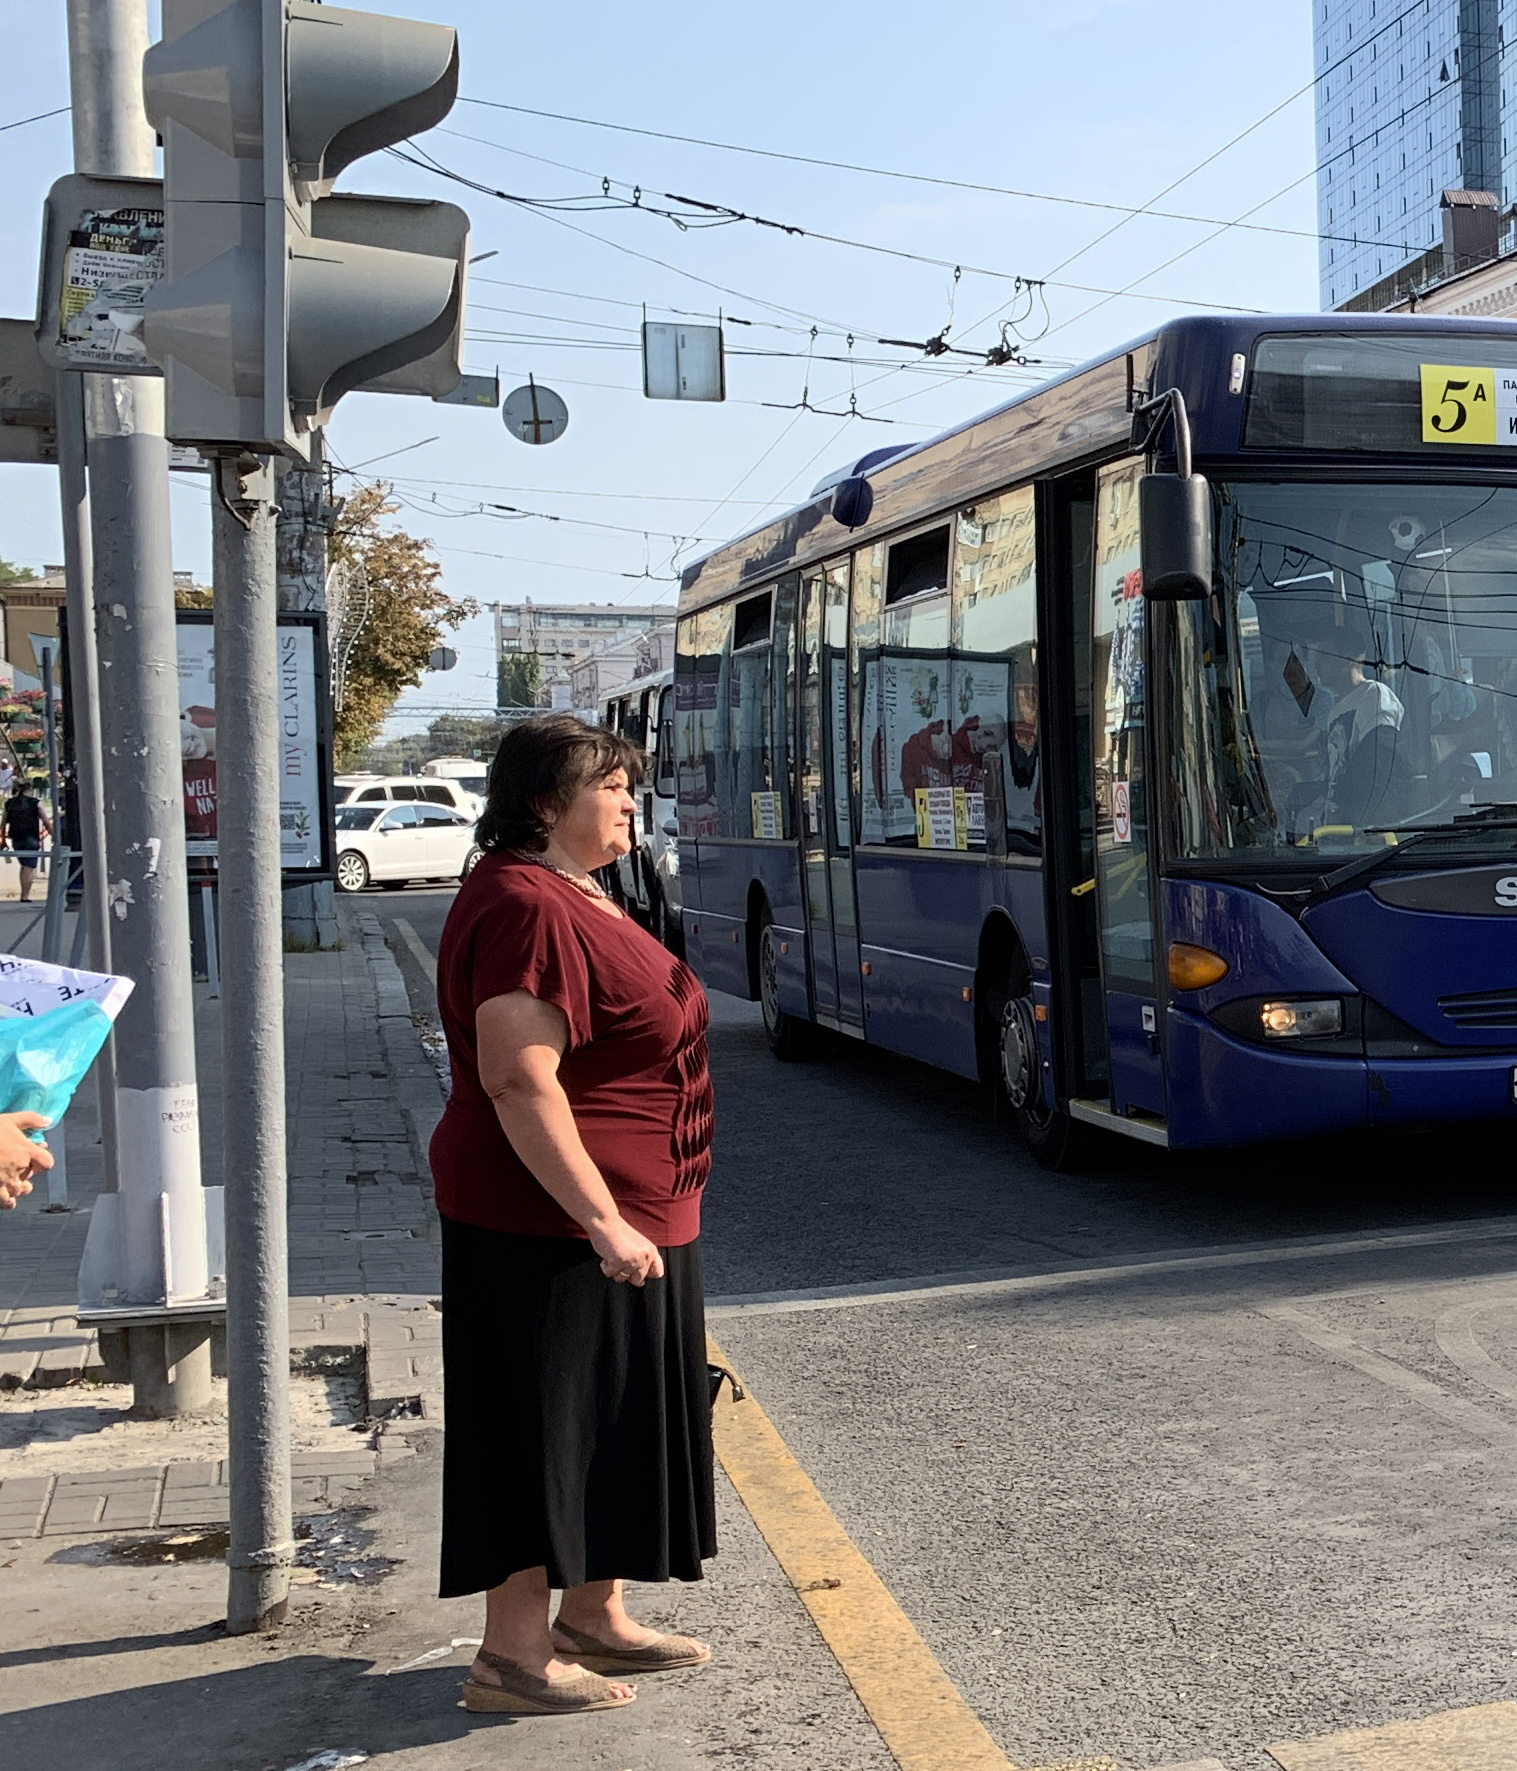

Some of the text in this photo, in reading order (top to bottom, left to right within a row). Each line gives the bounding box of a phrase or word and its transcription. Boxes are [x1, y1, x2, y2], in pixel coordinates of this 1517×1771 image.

[282, 636, 300, 738] CLARINS
[285, 743, 308, 777] my
[196, 796, 218, 816] NA
